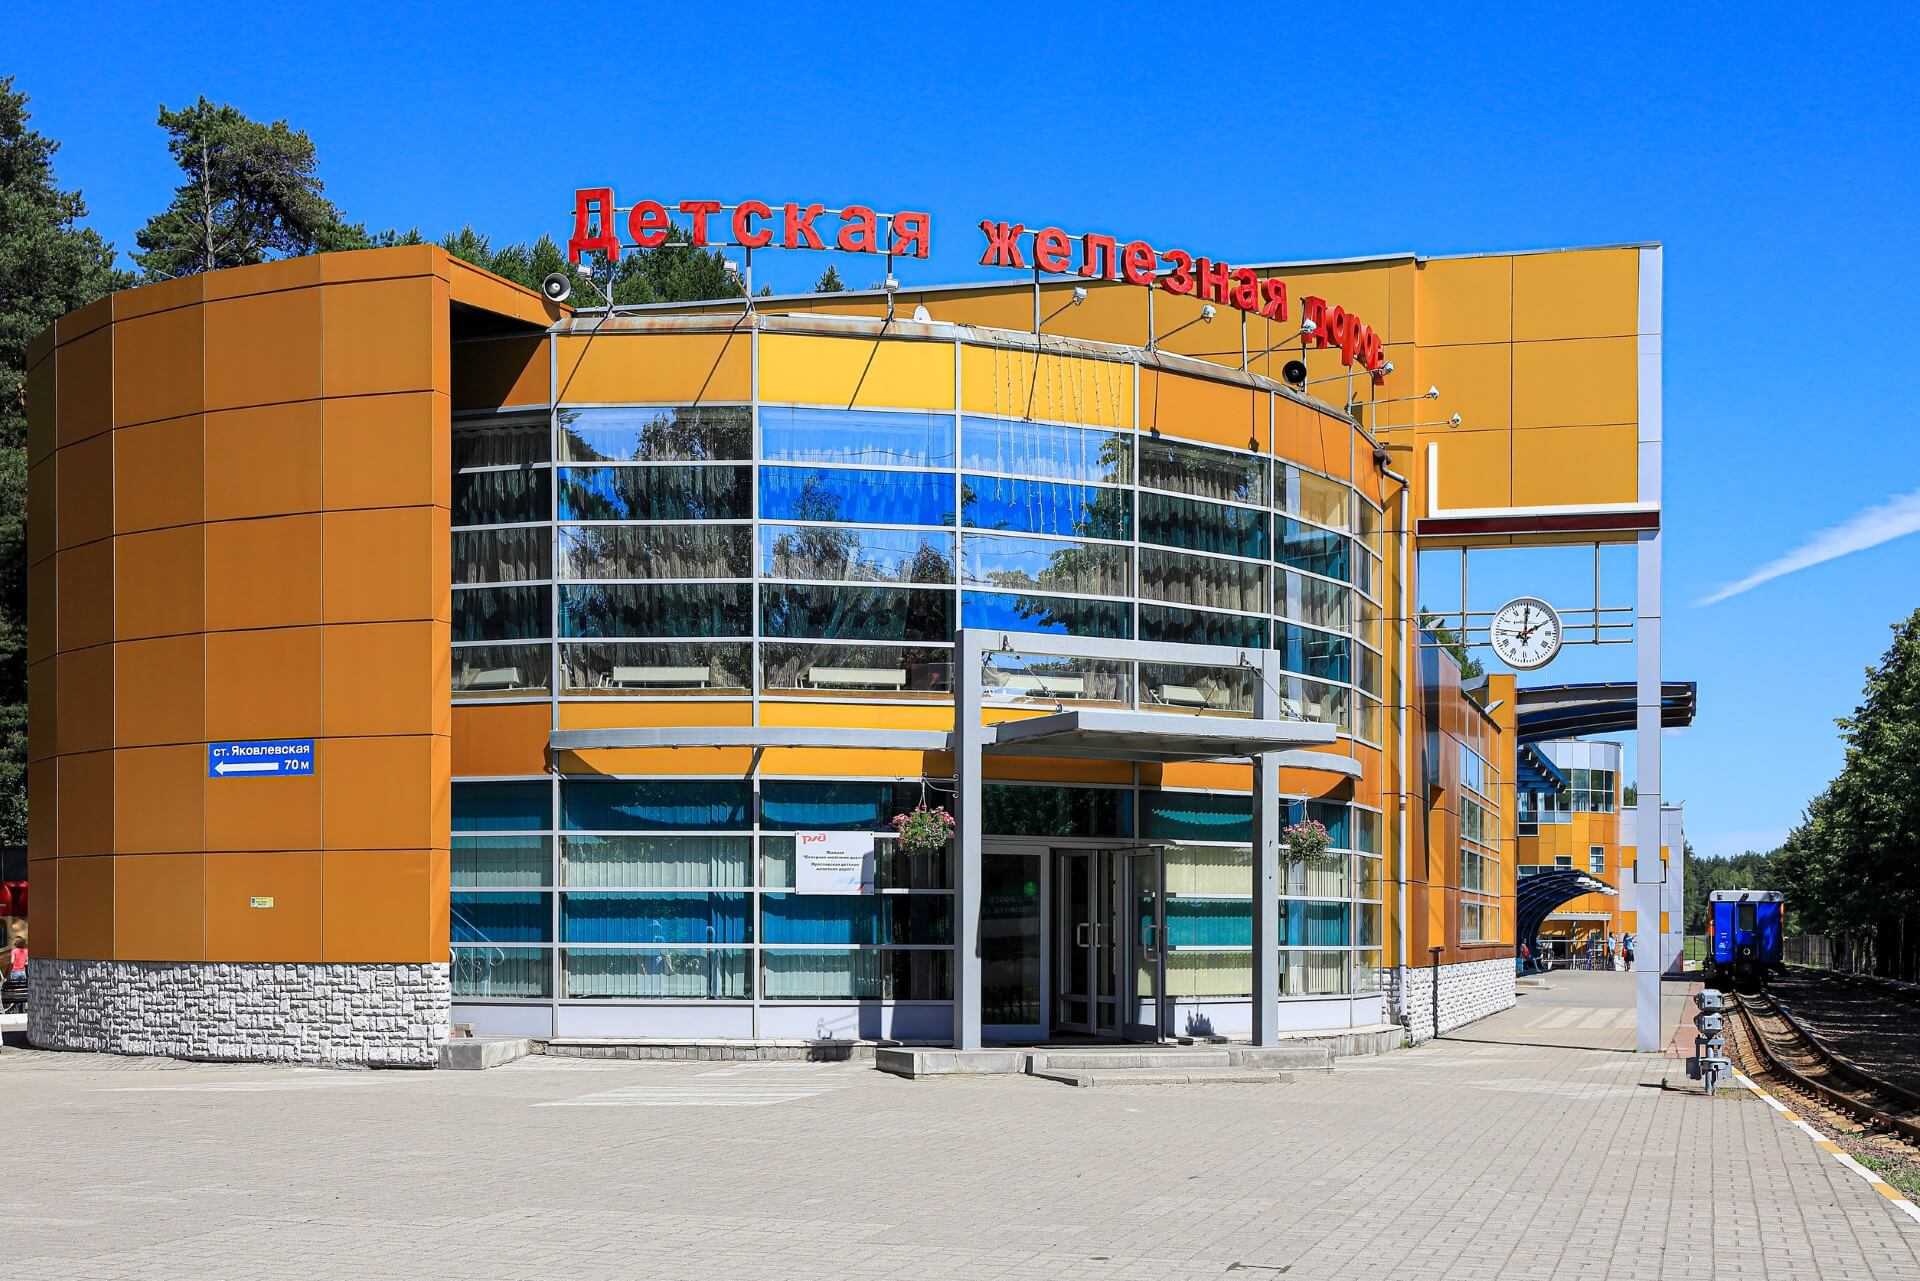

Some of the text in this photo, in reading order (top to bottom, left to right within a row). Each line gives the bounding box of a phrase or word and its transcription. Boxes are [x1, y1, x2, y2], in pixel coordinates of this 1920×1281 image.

[568, 187, 931, 264] Детская
[978, 219, 1289, 323] железная
[213, 745, 310, 757] ст. Яковлевская
[284, 759, 299, 770] 70
